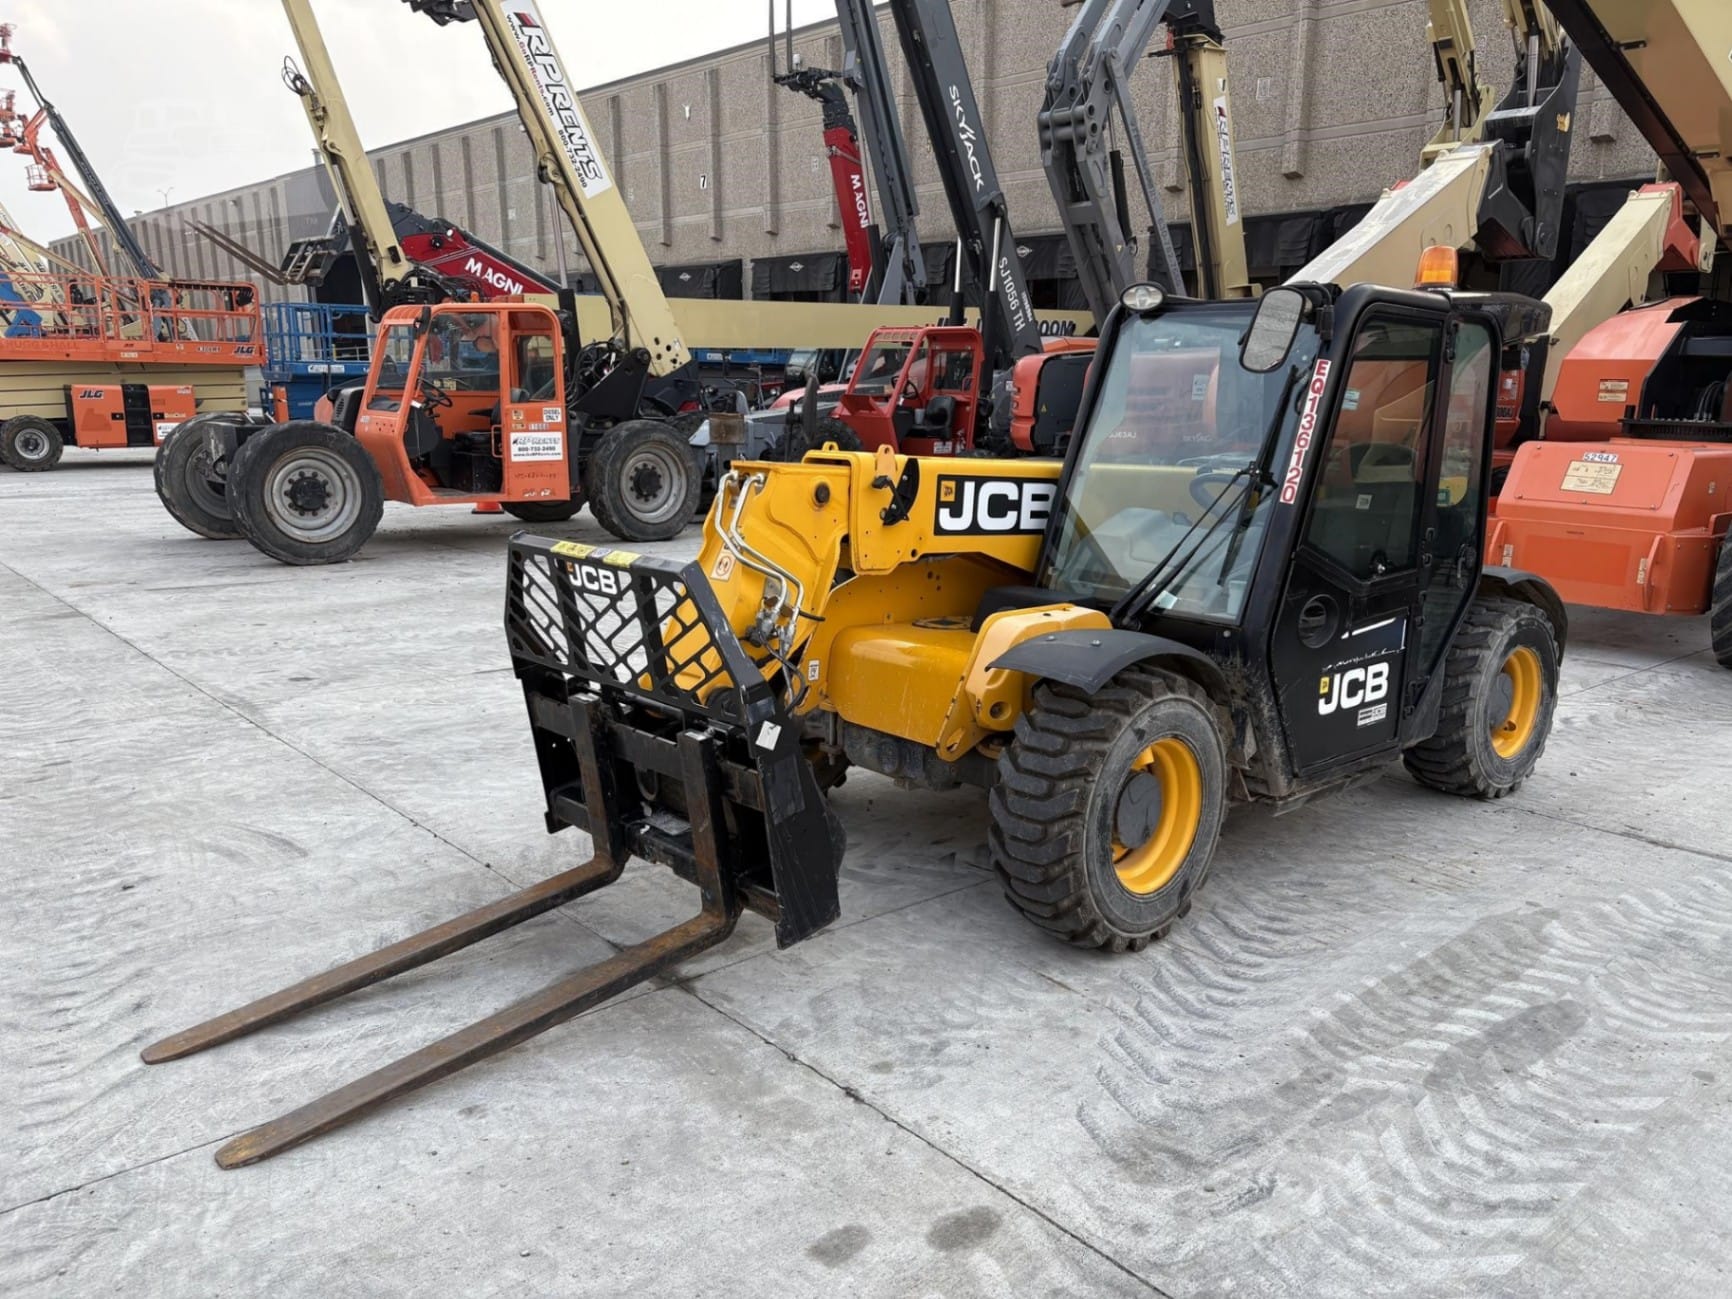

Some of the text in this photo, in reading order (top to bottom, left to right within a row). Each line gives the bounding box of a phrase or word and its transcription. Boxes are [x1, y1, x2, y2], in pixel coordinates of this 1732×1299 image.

[506, 14, 554, 117] www.GoRPRents.com
[519, 25, 603, 181] RP RENTS
[558, 129, 588, 189] 800-732-2490
[949, 84, 985, 193] SKYJACK
[701, 175, 706, 188] 7
[850, 174, 869, 229] MAGNI
[464, 257, 524, 295] MAGNI
[999, 256, 1026, 332] SJ1056 TH
[233, 346, 255, 355] JLG
[1035, 320, 1076, 337] OOM
[80, 390, 104, 399] JLG
[1282, 361, 1329, 503] EQ136120
[1584, 453, 1617, 463] 52947
[939, 481, 1057, 531] JCB
[568, 563, 618, 595] JCB
[1318, 661, 1390, 716] JCB
